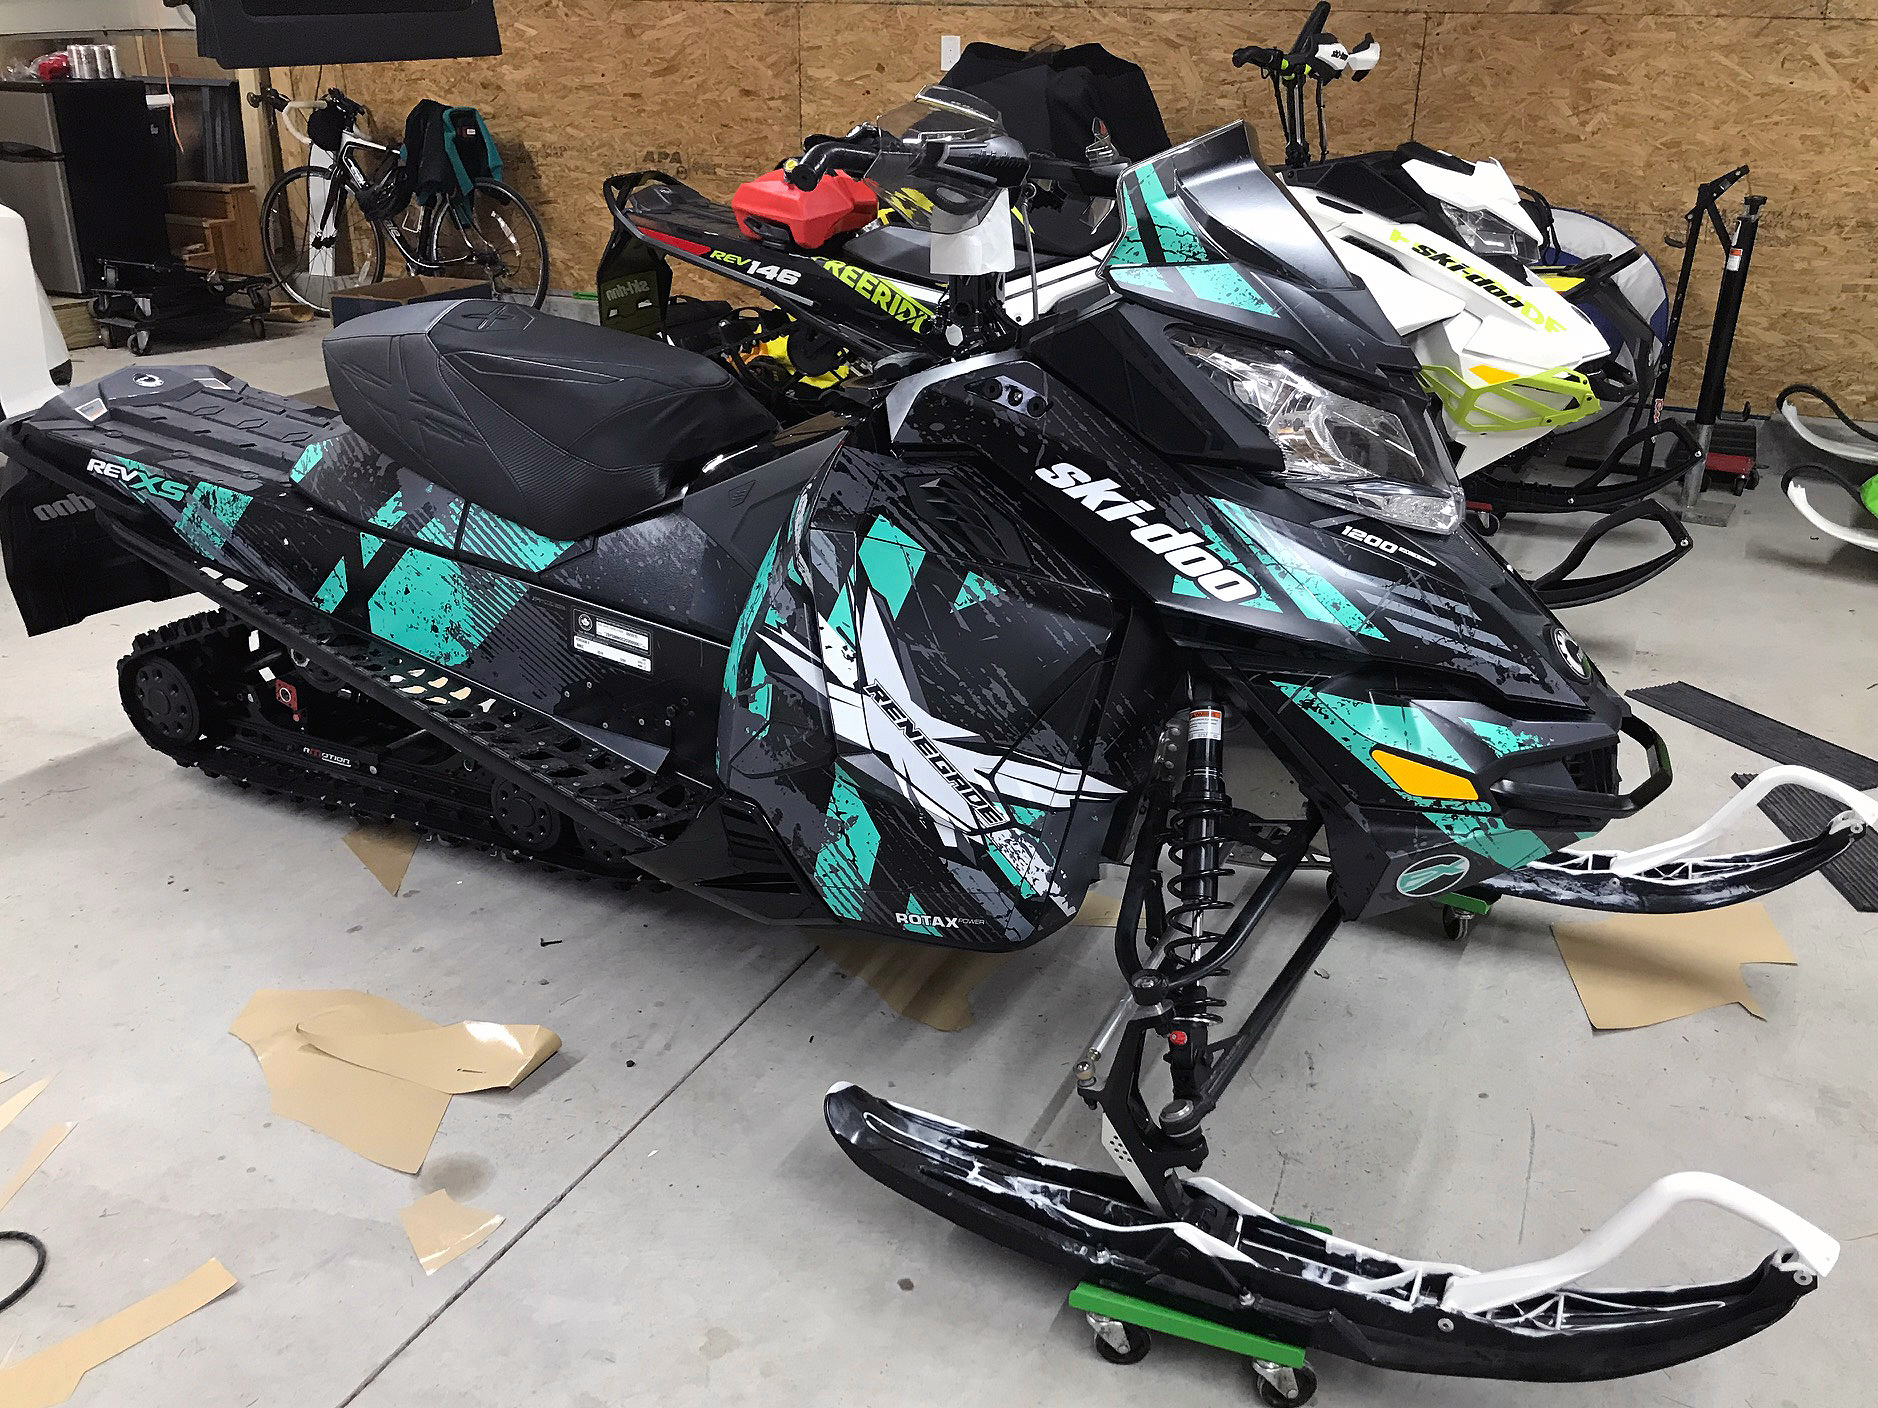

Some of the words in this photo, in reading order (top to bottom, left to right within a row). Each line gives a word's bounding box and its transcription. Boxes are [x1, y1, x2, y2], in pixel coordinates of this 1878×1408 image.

[642, 150, 682, 163] APA
[710, 250, 751, 266] REV
[747, 260, 801, 286] 146
[1411, 244, 1525, 309] ski-doo
[1034, 462, 1259, 602] ski-doo
[1341, 525, 1399, 554] 1200
[864, 680, 1006, 825] RENEGADE
[895, 912, 960, 929] ROTAX
